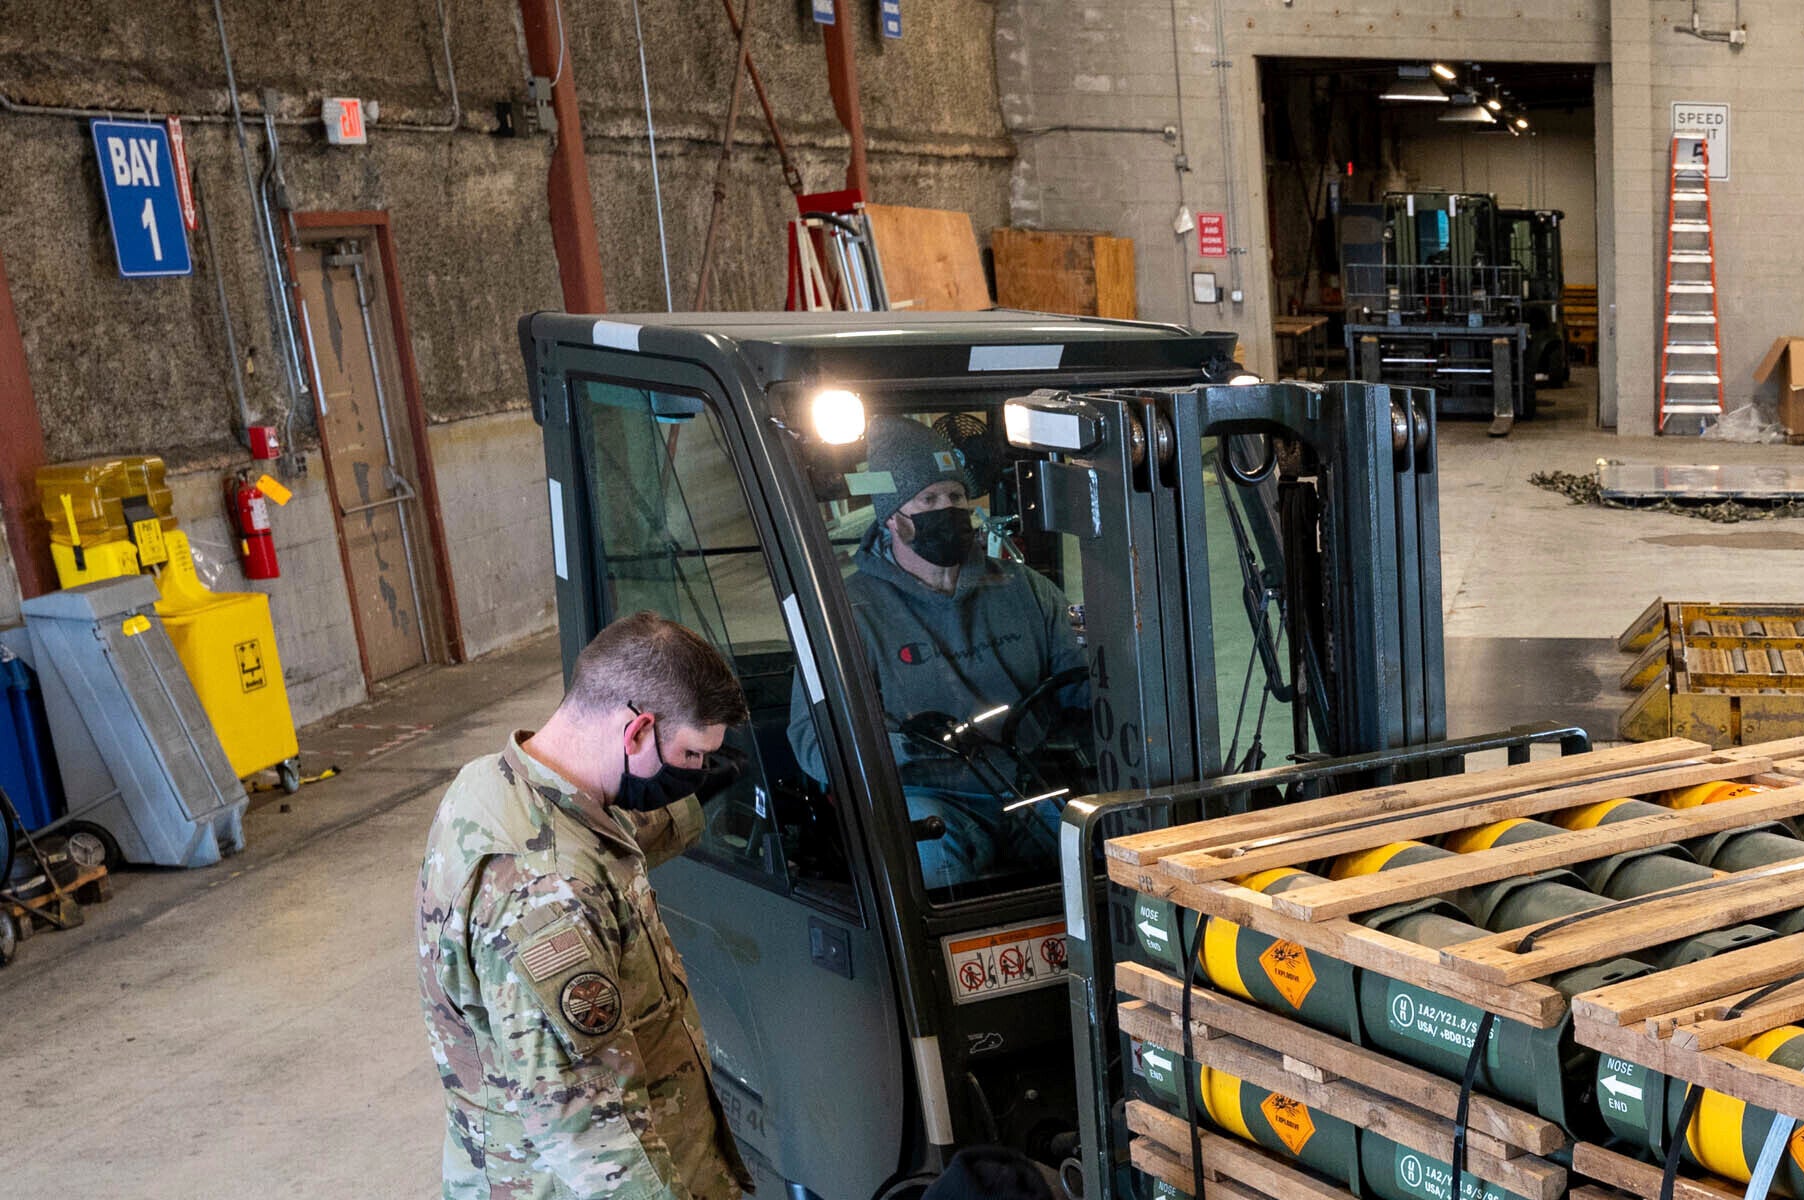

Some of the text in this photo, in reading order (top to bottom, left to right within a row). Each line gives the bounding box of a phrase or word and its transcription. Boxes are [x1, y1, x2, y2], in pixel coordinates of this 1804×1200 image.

[1678, 112, 1724, 125] SPEED
[107, 137, 160, 187] BAY
[141, 198, 163, 261] 1
[1139, 905, 1160, 922] NOSE
[1416, 1019, 1438, 1038] USA/
[1418, 1003, 1495, 1040] 1A2/Y21.8/S6
[1607, 1057, 1634, 1078] NOSE
[1608, 1097, 1628, 1113] END
[1157, 1180, 1177, 1197] NOSE
[1424, 1181, 1445, 1199] USA/
